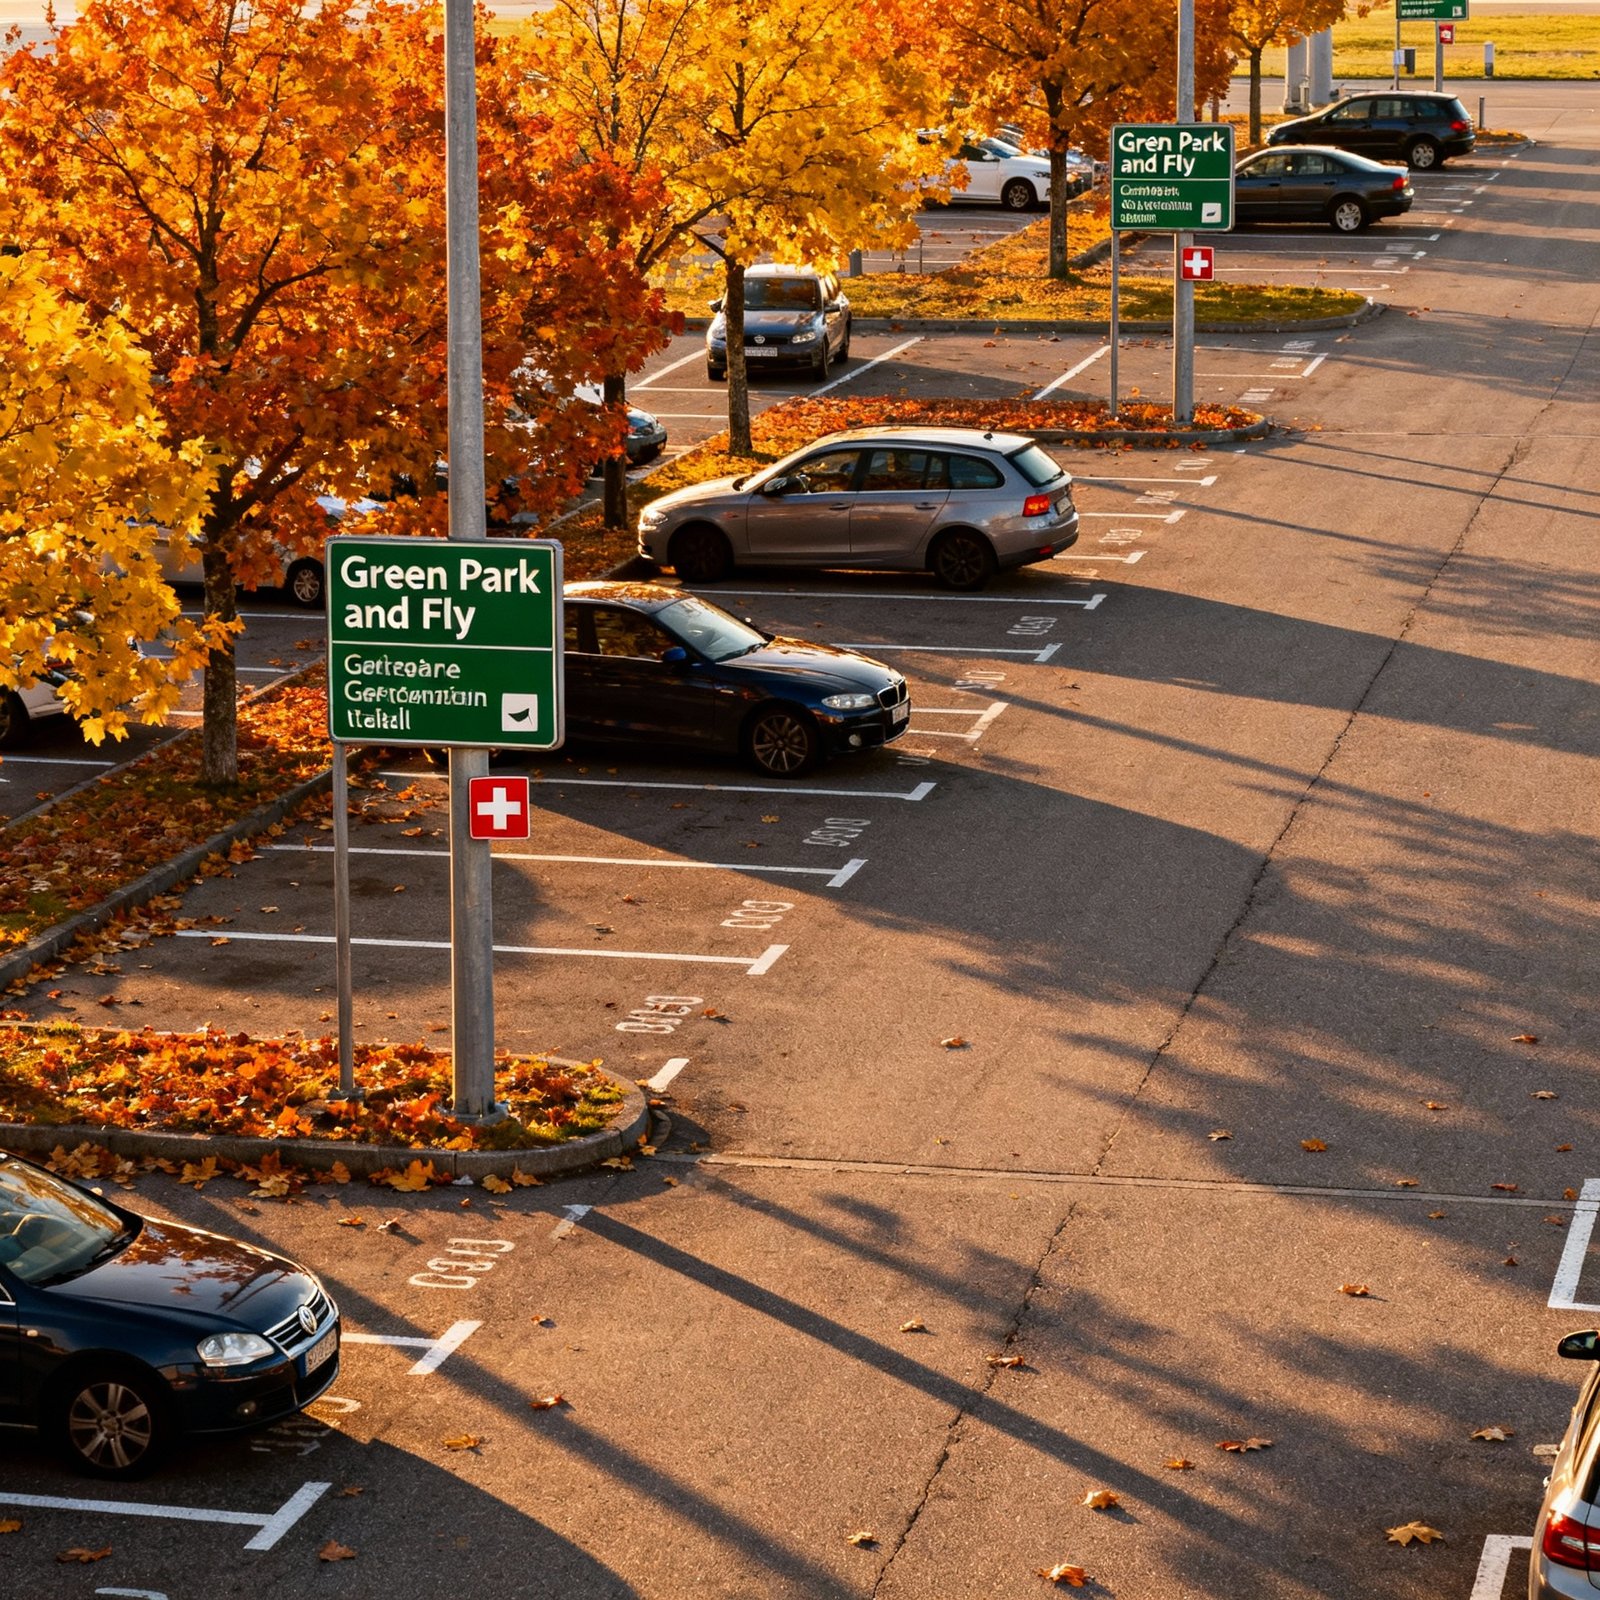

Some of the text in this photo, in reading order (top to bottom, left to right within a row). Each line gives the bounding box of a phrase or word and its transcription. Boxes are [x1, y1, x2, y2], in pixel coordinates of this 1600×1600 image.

[1118, 130, 1226, 153] Gren Park
[1120, 153, 1196, 177] and Fly
[340, 555, 541, 594] Green Park
[344, 595, 476, 641] and Fly
